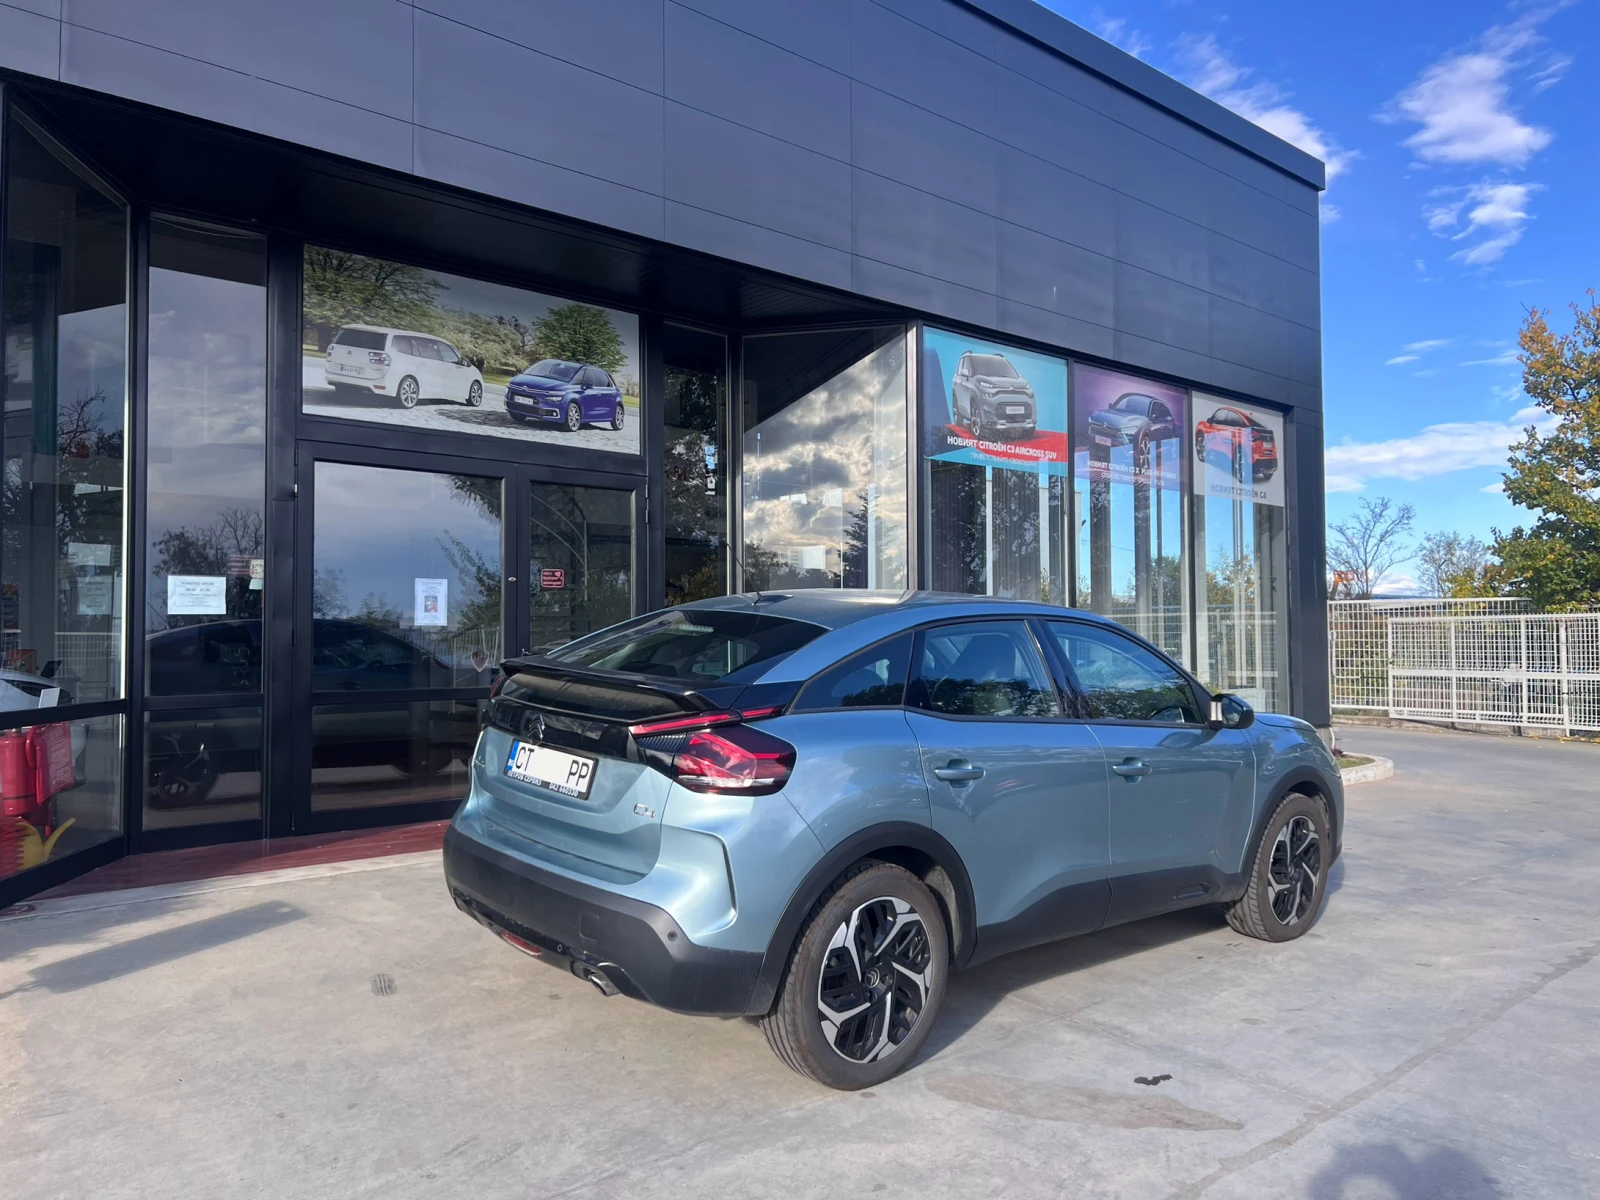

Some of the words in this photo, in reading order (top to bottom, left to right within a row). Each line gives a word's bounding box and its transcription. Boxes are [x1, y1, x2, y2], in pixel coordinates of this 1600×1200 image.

[947, 436, 978, 449] НОВИЯТ
[979, 440, 1006, 453] CITROËN
[1007, 445, 1015, 454] C3
[1015, 446, 1044, 458] AIRCROSS
[1045, 451, 1057, 460] SUV
[1260, 491, 1267, 499] C4
[507, 770, 524, 781] ПЕТРОВ
[524, 774, 542, 786] СЕРВИЗ
[566, 759, 590, 787] PP
[549, 782, 558, 792] 042
